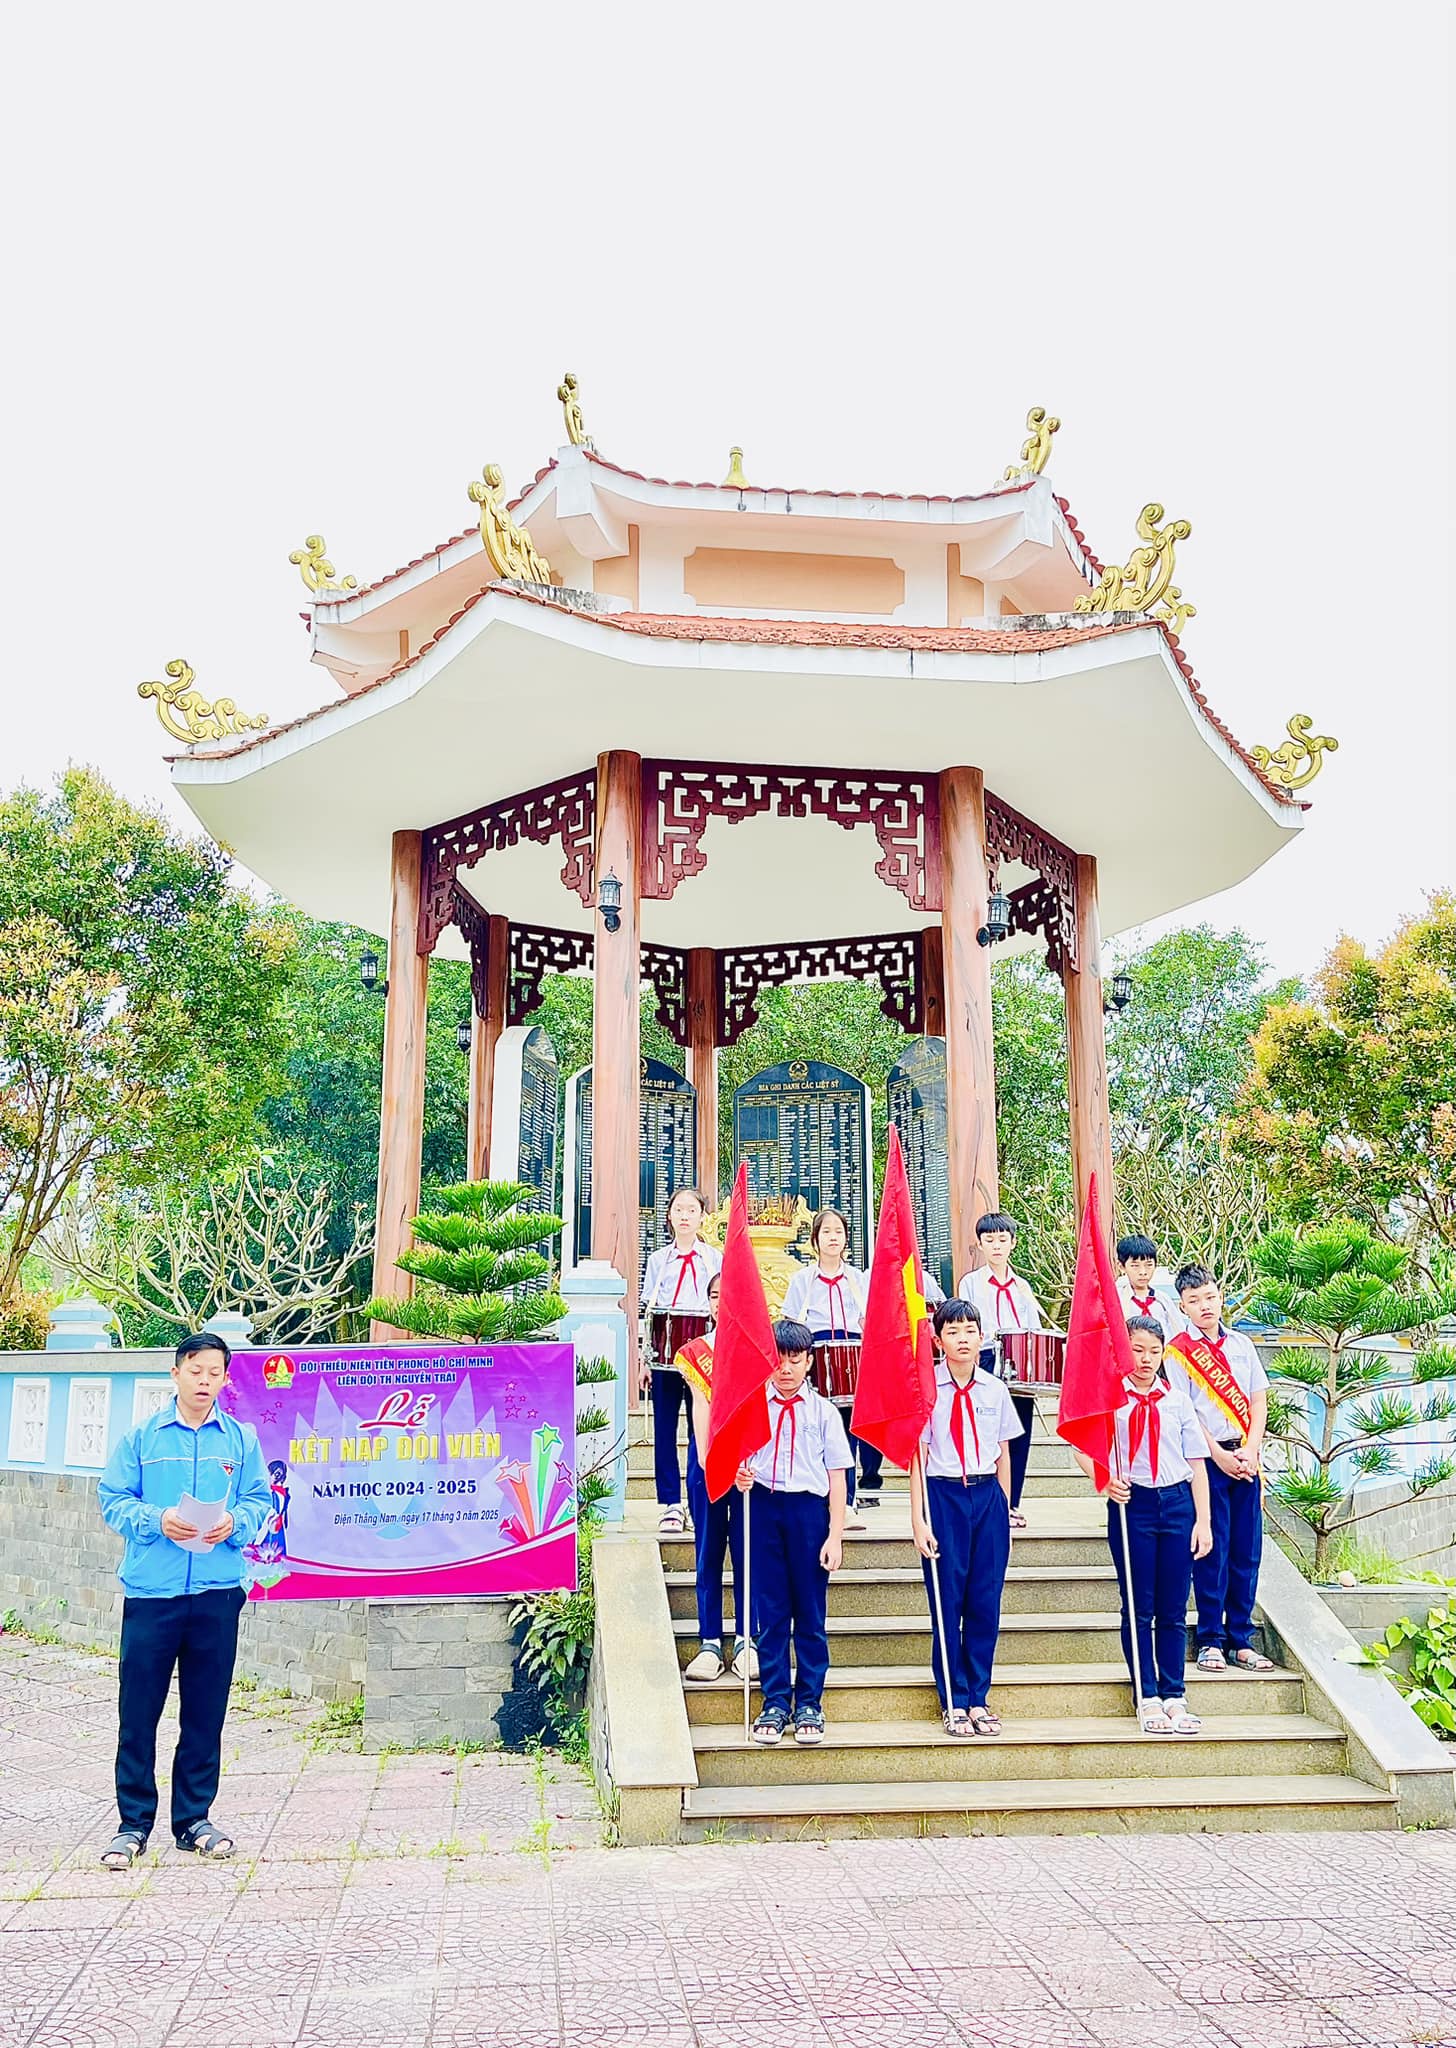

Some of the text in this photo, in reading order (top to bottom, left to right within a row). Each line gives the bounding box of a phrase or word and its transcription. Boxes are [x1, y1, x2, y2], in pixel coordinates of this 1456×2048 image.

[300, 1355, 493, 1373] ĐỘI THIẾU NIÊN TIỀN PHONG HỒ CHÍ MINH
[1190, 1348, 1215, 1372] LIÊN
[1209, 1367, 1231, 1390] ĐỘI
[337, 1374, 357, 1386] LIÊN
[360, 1374, 377, 1387] ĐỘI
[380, 1375, 392, 1385] TH
[395, 1371, 431, 1384] NGUYỄN
[358, 1391, 435, 1429] Lễ
[289, 1427, 502, 1467] KẾT NẠP ĐỘI VIÊN
[312, 1481, 345, 1498] NĂM
[349, 1482, 382, 1500] HỌC
[386, 1481, 425, 1496] 2024
[437, 1479, 477, 1494] 2025
[334, 1513, 352, 1527] Điện
[401, 1512, 420, 1525] ngày
[422, 1511, 431, 1522] 17
[431, 1510, 455, 1524] tháng
[455, 1510, 461, 1521] 3
[462, 1510, 479, 1521] năm
[480, 1509, 499, 1521] 2025
